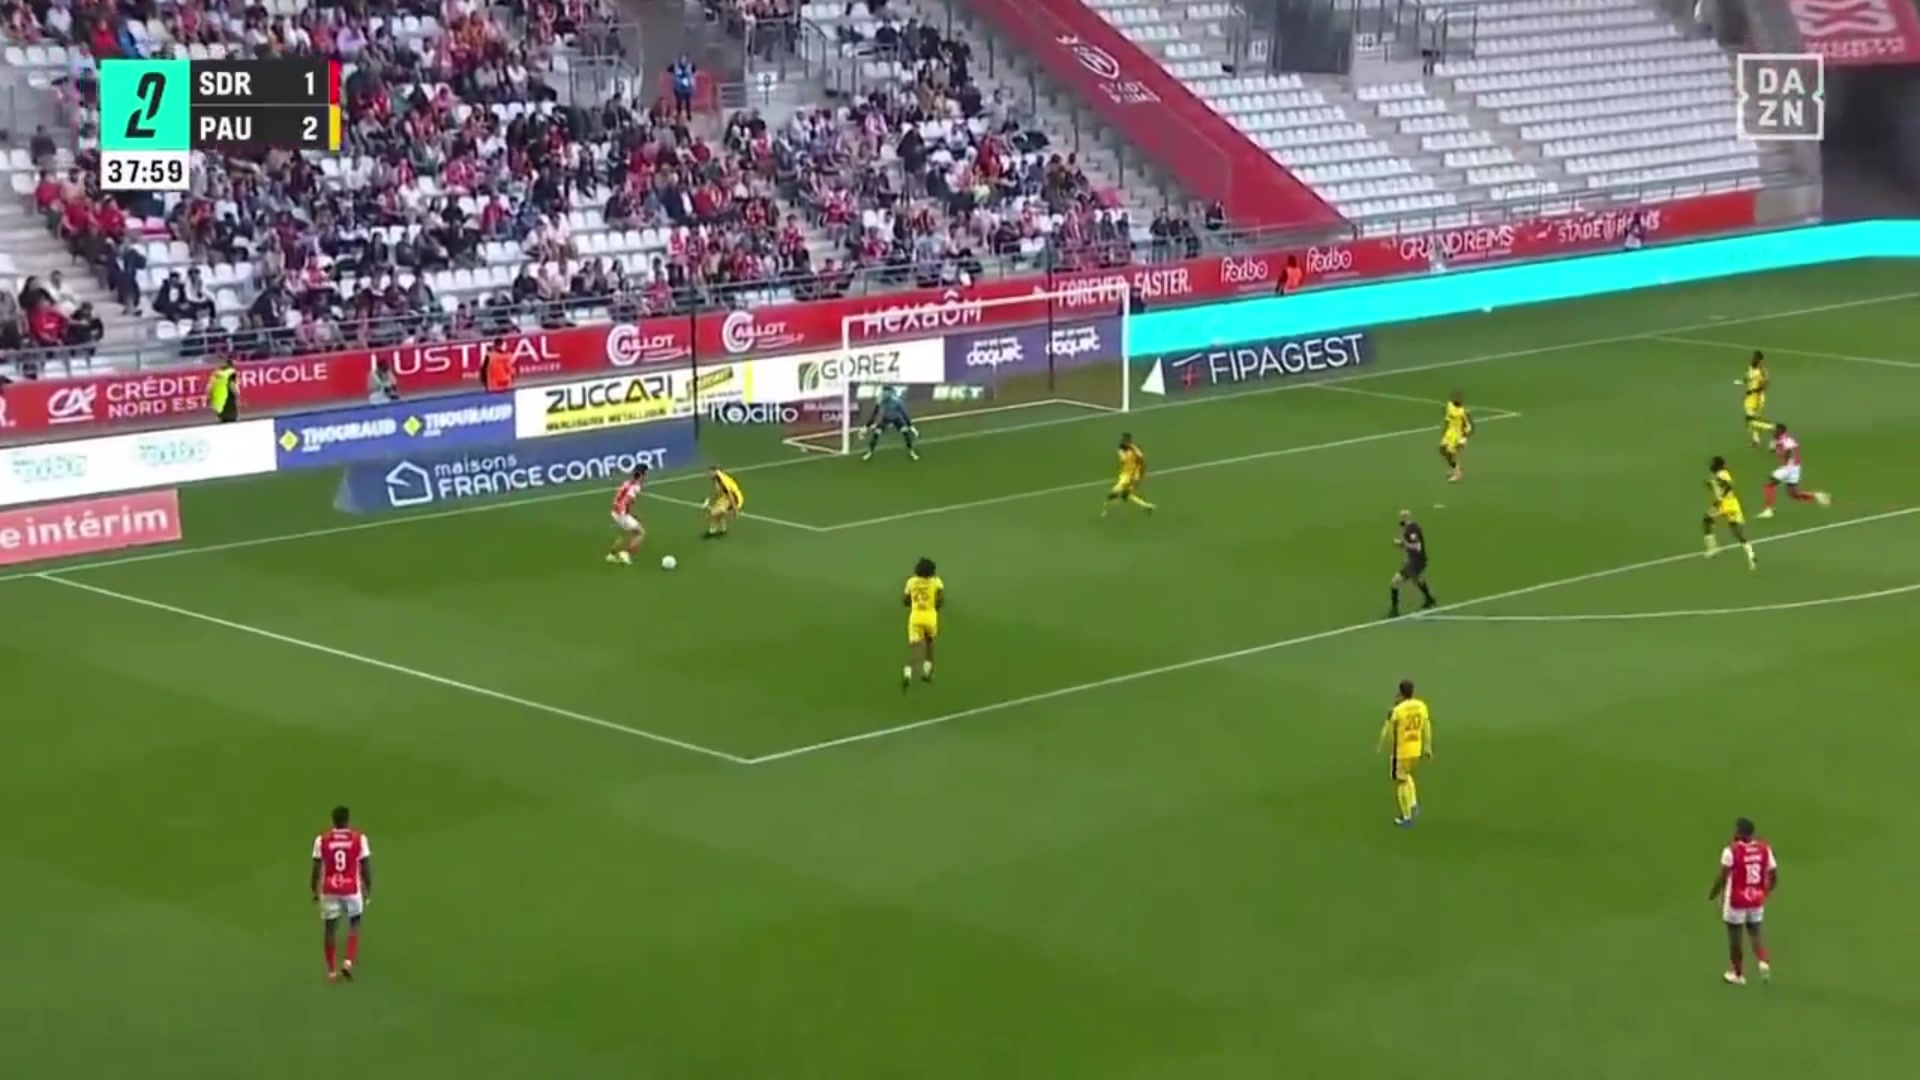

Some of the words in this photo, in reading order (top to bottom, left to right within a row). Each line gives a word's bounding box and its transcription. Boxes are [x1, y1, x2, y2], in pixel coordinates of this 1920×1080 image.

[821, 351, 900, 380] GOREZ
[1208, 333, 1364, 385] FIPAGEST
[106, 373, 202, 403] CRÉDIT
[236, 362, 329, 388] RICOLE
[546, 374, 674, 414] ZUCCARI
[108, 401, 168, 419] NORD
[172, 396, 208, 412] EST
[434, 453, 518, 477] maisons
[437, 468, 543, 500] FRANCE
[548, 448, 668, 483] CONFORT
[26, 505, 169, 546] intérim
[334, 849, 347, 872] 9
